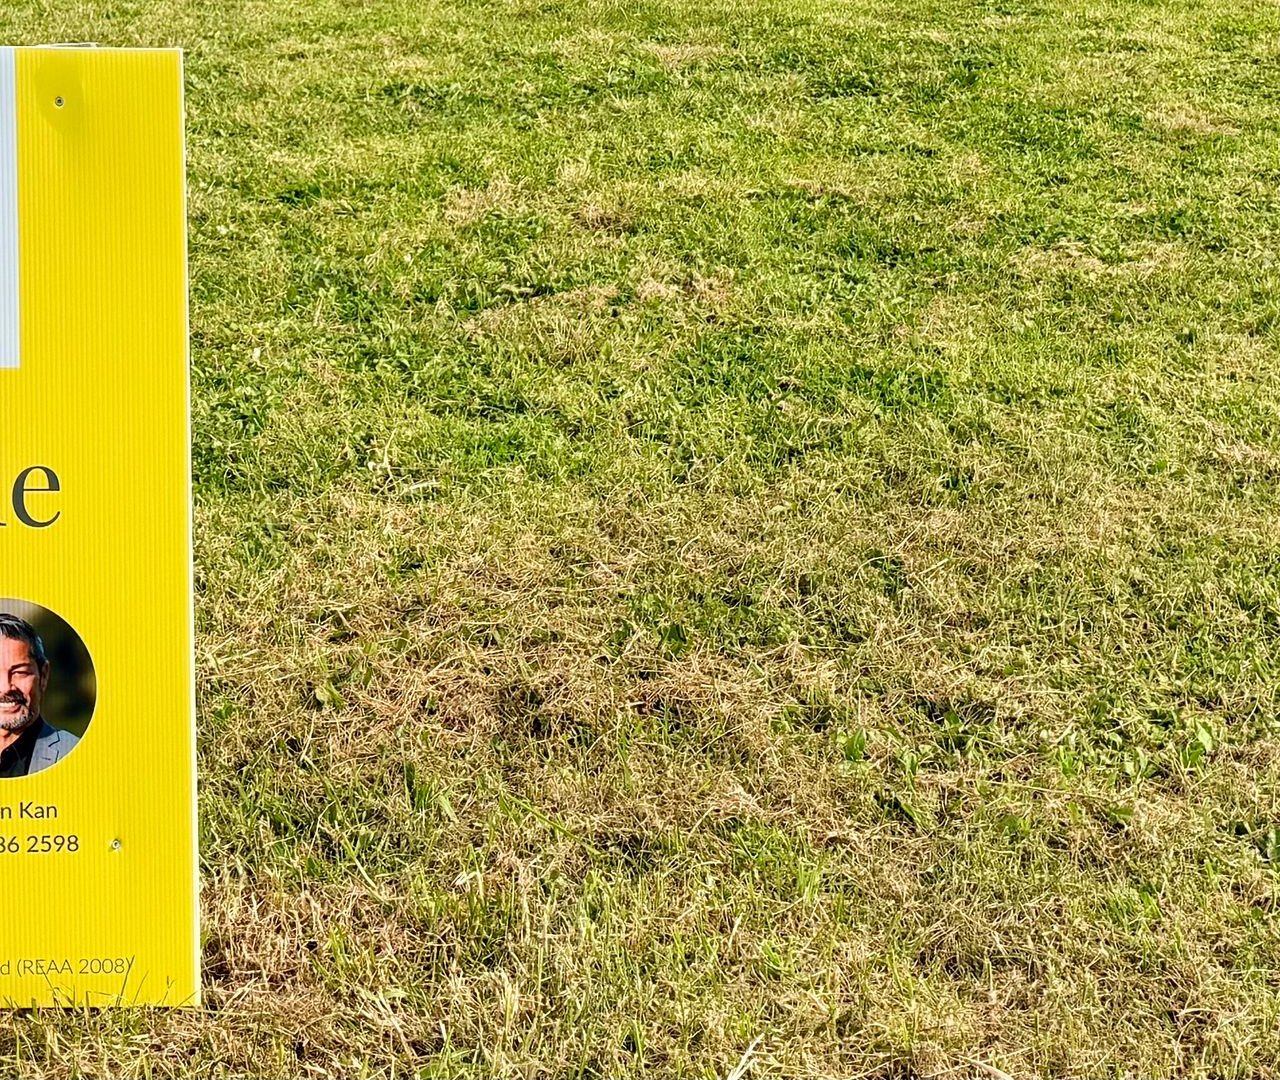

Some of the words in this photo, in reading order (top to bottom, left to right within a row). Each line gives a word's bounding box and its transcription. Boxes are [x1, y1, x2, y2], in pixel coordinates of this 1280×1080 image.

[19, 801, 58, 819] Kan
[26, 834, 80, 853] 2598
[16, 958, 74, 979] (REAA
